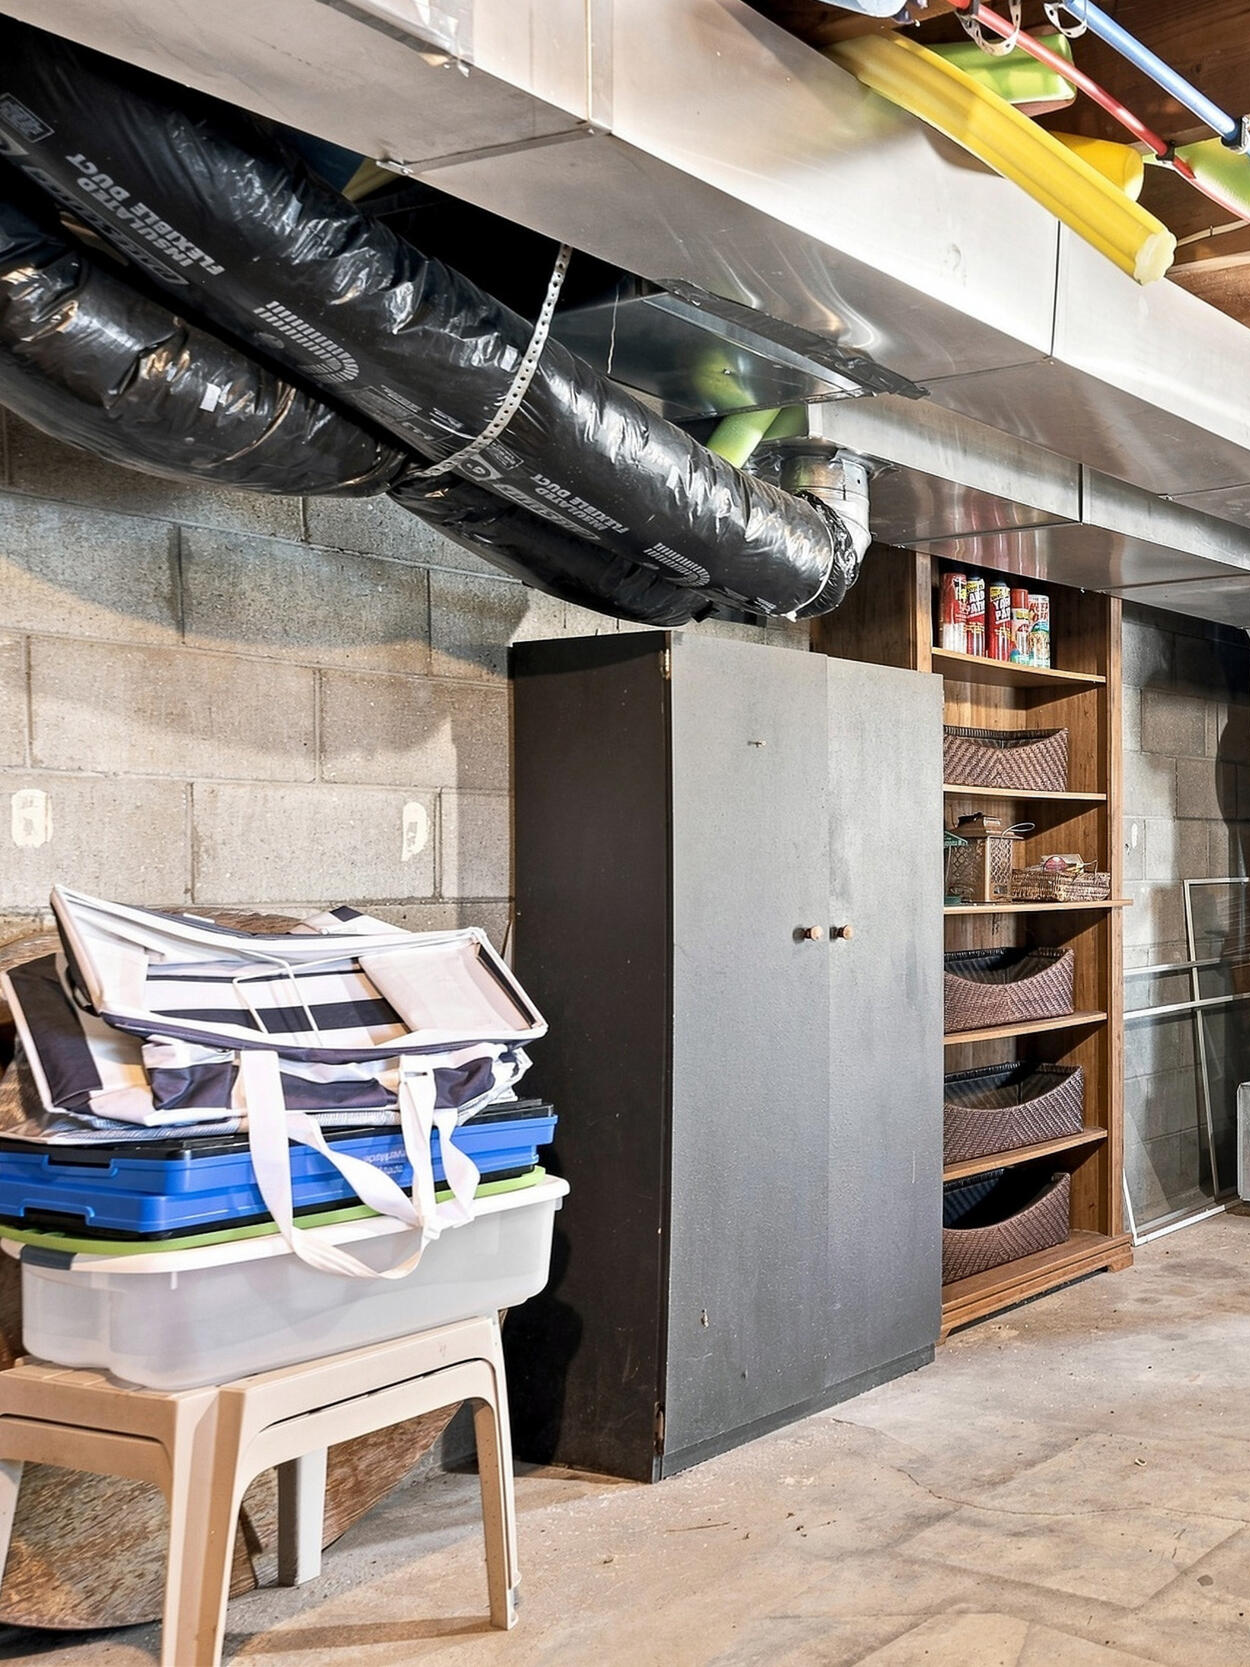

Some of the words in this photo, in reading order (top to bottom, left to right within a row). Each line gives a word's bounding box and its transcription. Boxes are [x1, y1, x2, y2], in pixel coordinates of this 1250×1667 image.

[65, 153, 131, 201] DUCT
[77, 177, 194, 267] INSULATED
[129, 202, 226, 276] FLEXIBLE
[529, 473, 572, 498] DUCT
[534, 487, 608, 531] INSULATED
[569, 496, 630, 534] FLEXIBLE
